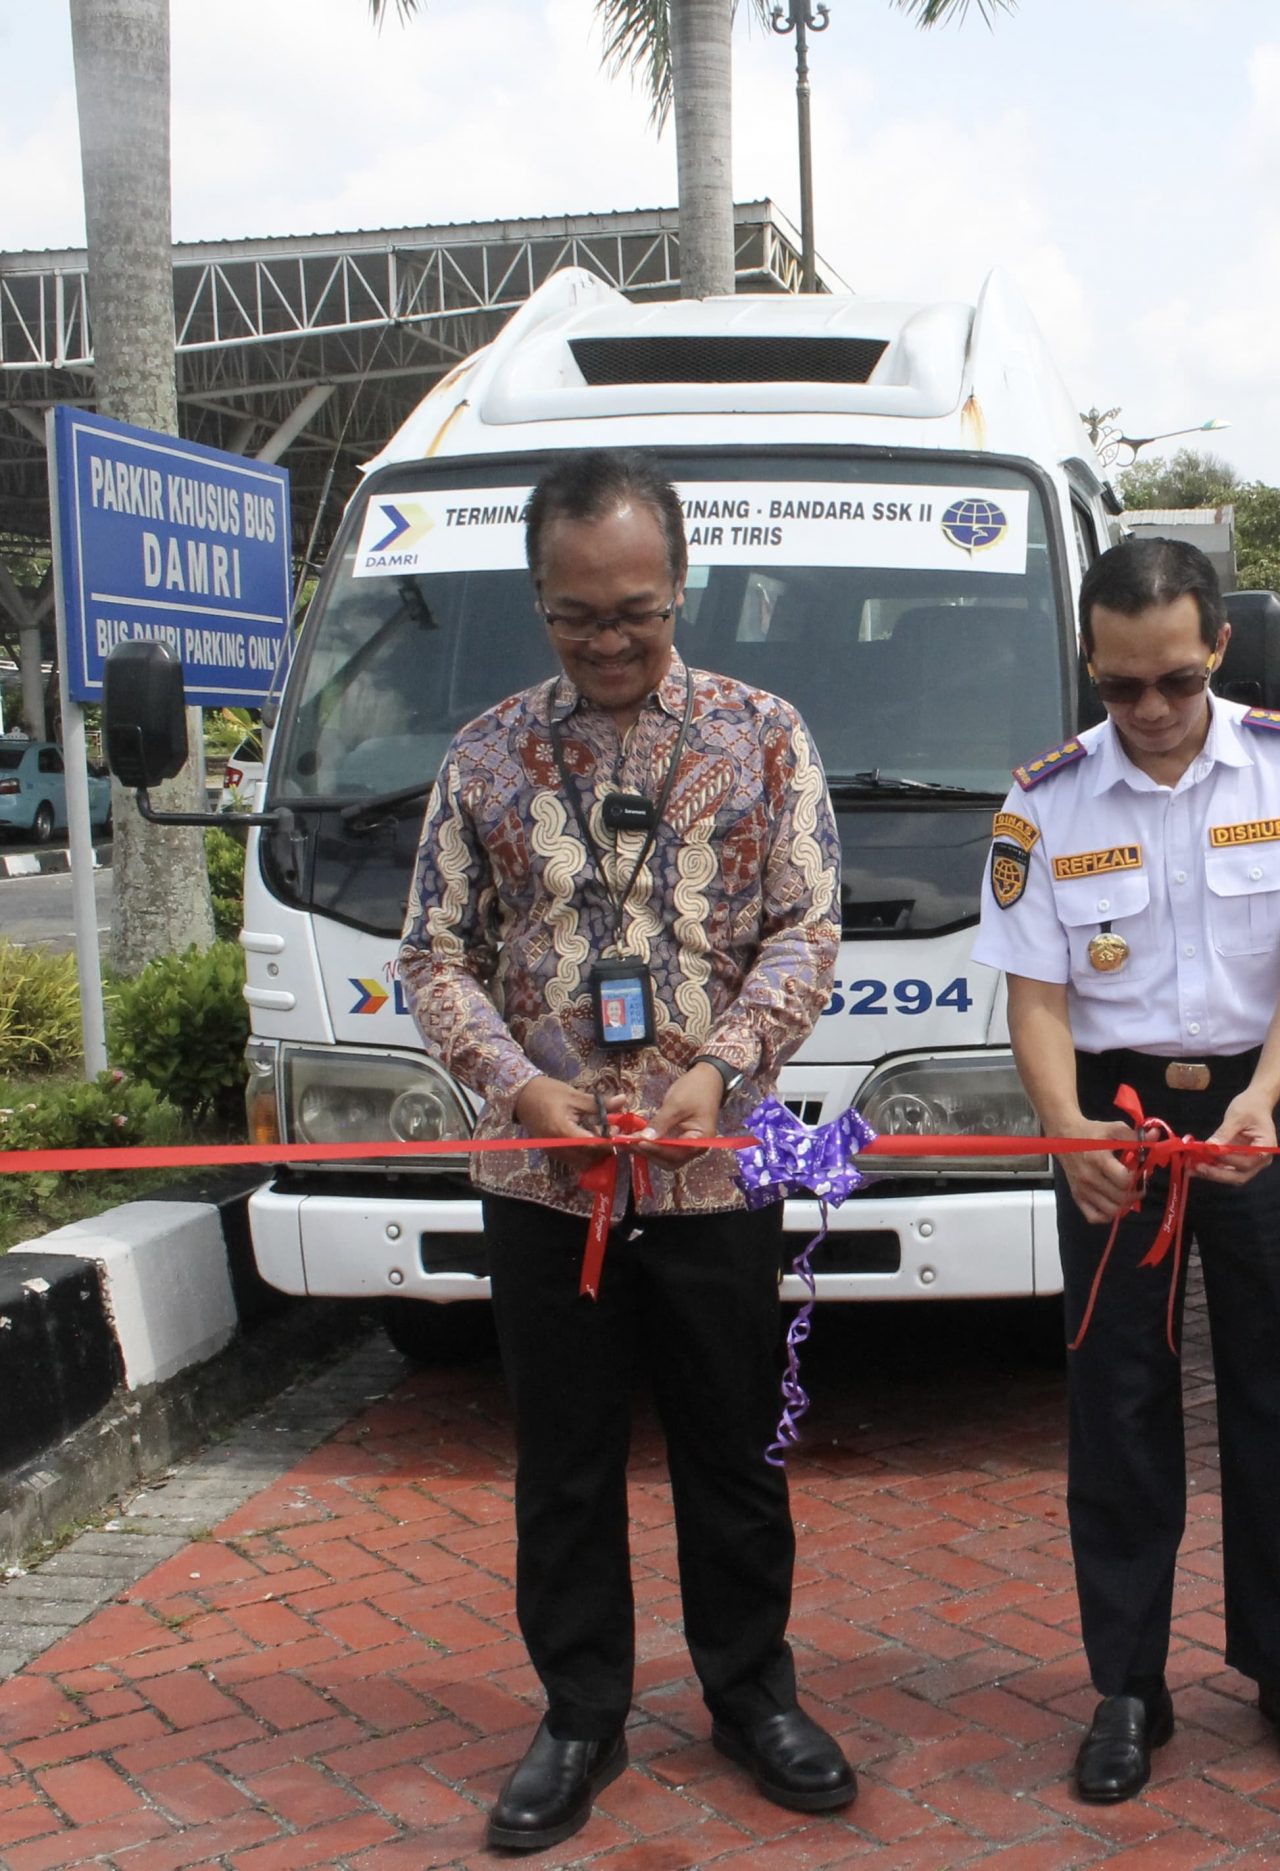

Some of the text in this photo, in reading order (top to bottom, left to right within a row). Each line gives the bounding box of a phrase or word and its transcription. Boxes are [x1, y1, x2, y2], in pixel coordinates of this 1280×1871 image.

[90, 456, 276, 543] PARKIR KHUSUS BUS
[446, 505, 529, 526] TERMINA
[679, 500, 749, 519] INANG
[769, 501, 865, 520] BANDARA
[872, 502, 912, 522] SSK
[919, 504, 932, 522] II
[689, 527, 782, 546] AIR TIRIS
[143, 532, 241, 599] DAMRI
[365, 555, 418, 568] DAMRI
[185, 628, 245, 668] PARKING
[248, 635, 281, 671] ONLY
[997, 815, 1033, 837] DINAS
[1057, 848, 1137, 875] REFIZAL
